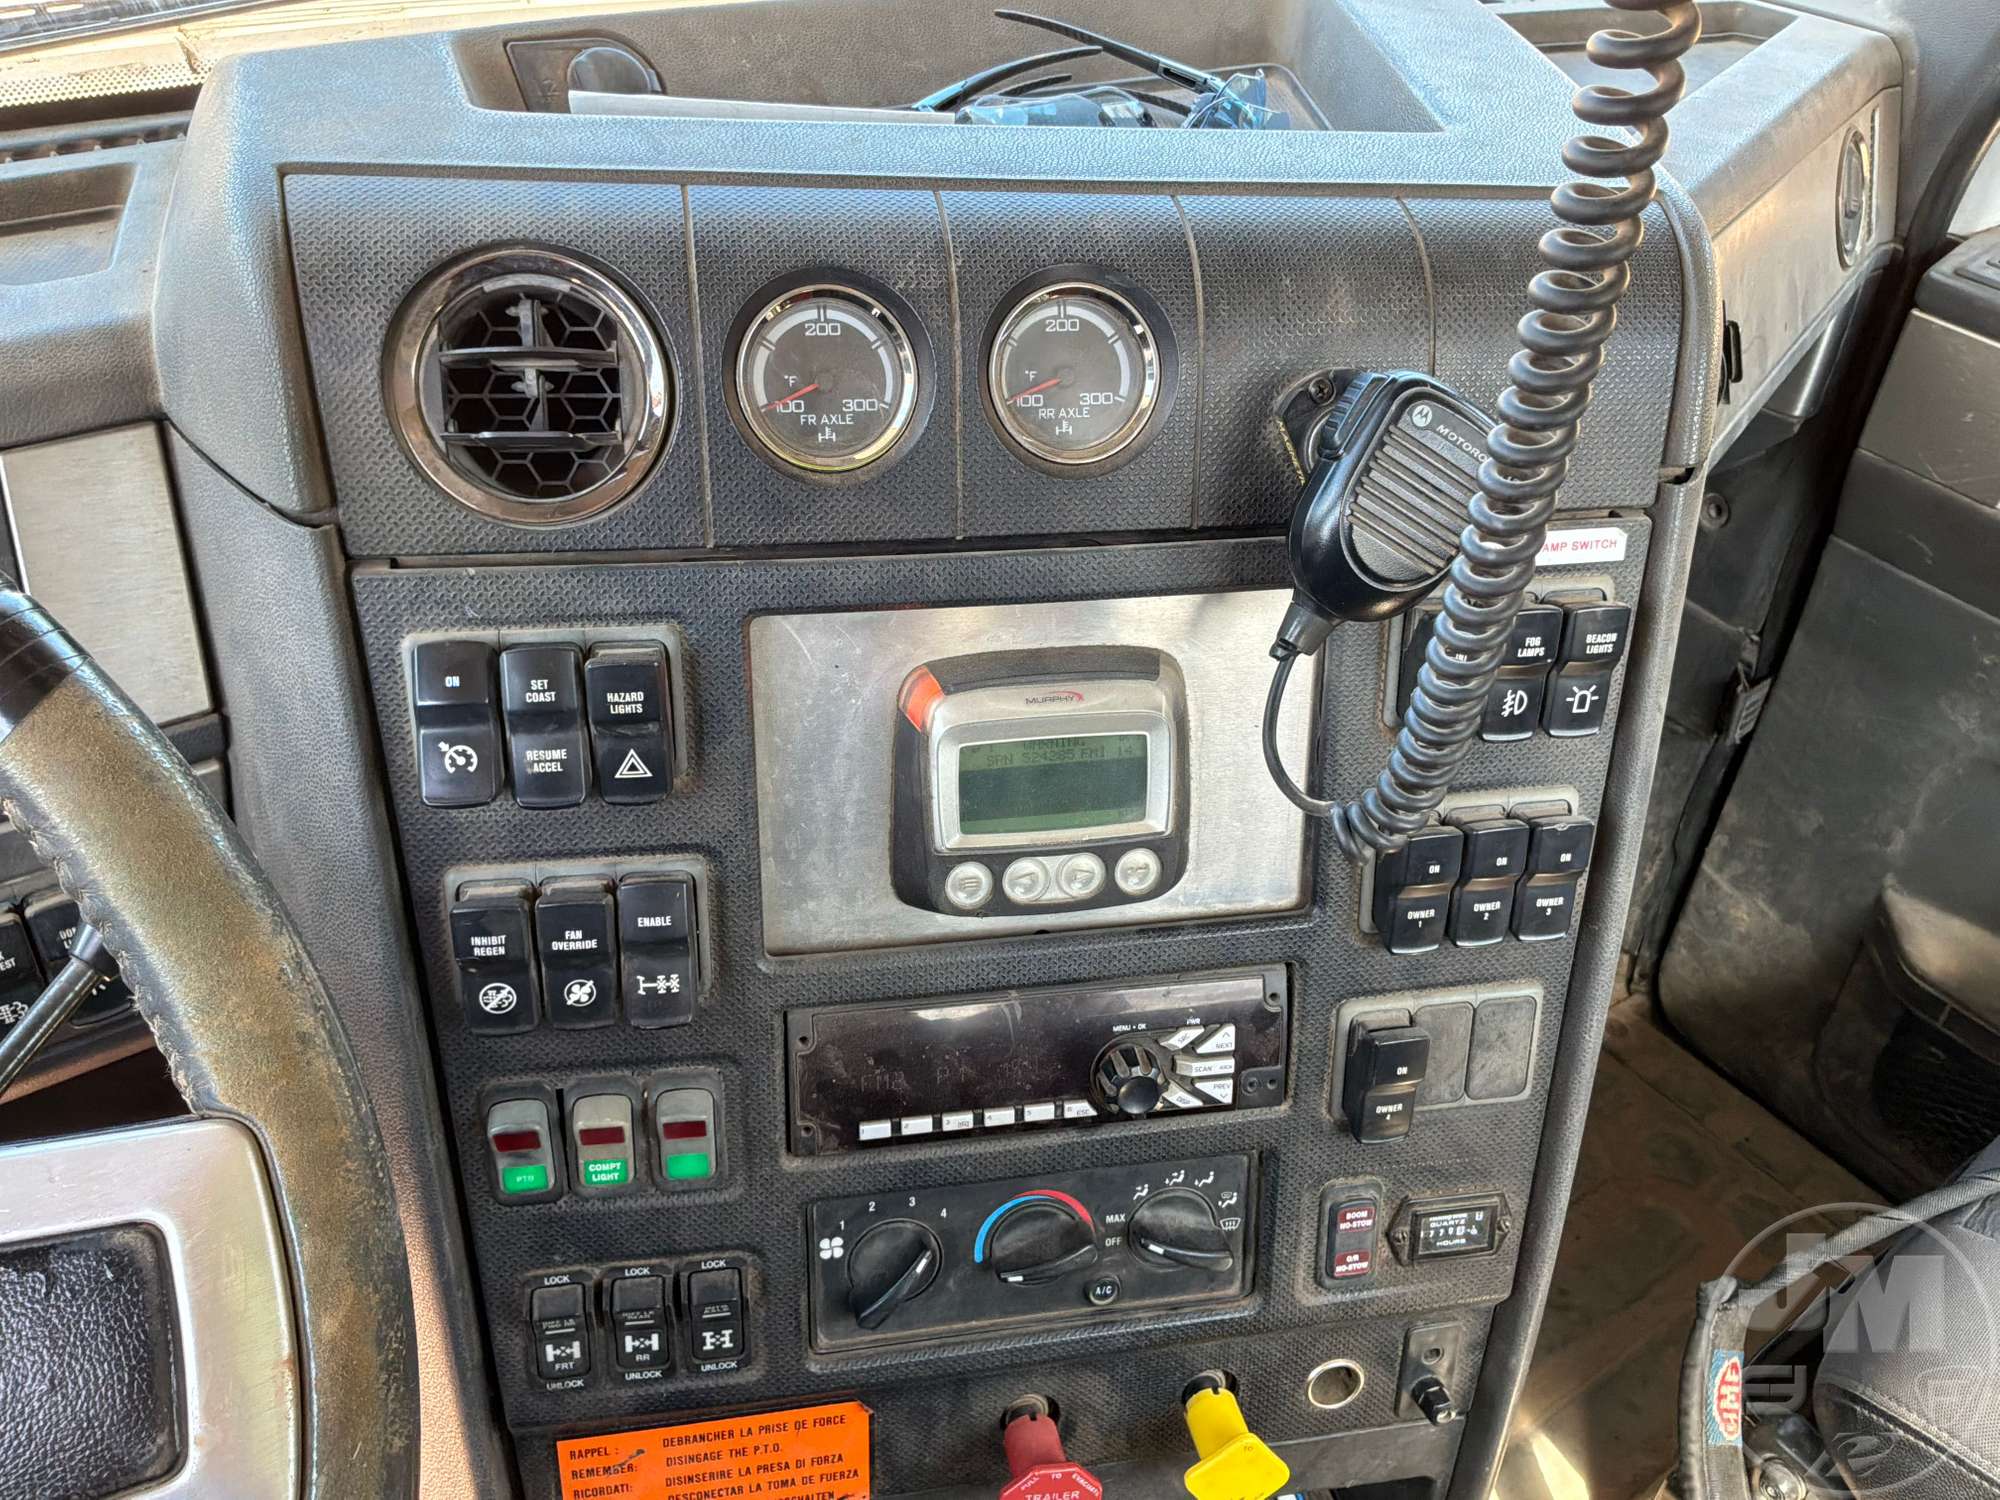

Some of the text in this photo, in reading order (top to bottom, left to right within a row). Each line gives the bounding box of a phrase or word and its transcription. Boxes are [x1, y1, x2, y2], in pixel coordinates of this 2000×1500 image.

[804, 323, 841, 337] 200
[1045, 319, 1080, 332] 200
[1079, 392, 1113, 406] 300
[842, 398, 878, 412] 300
[1038, 407, 1090, 419] RR AXLE
[800, 413, 854, 425] FR AXLE
[1436, 424, 1493, 463] MOTORO
[1542, 539, 1617, 552] AMP SWITCH
[1525, 637, 1541, 647] FOG
[1586, 633, 1618, 644] BEACON
[1517, 647, 1545, 657] LAMPS
[1586, 644, 1613, 654] LIGHTS
[445, 676, 460, 687] ON
[530, 679, 549, 690] SET
[525, 691, 556, 703] COAST
[607, 691, 644, 703] HAZARD
[1025, 694, 1075, 704] MURPHY
[610, 704, 643, 714] LIGHTS
[526, 749, 568, 760] RESUME
[532, 762, 563, 773] ACCEL
[1496, 857, 1507, 866] ON
[1560, 853, 1572, 862] ON
[1429, 865, 1440, 874] ON
[1473, 901, 1501, 911] OWNER
[1536, 897, 1564, 907] OWNER
[1407, 909, 1435, 919] OWNER
[1483, 912, 1489, 920] 2
[637, 916, 672, 927] ENABLE
[471, 935, 507, 946] INHIBIT
[565, 930, 583, 940] FAN
[551, 939, 598, 950] OVERRIDE
[473, 946, 505, 957] REGEN
[1397, 1066, 1408, 1075] ON
[1376, 1103, 1403, 1114] OWNER
[588, 1162, 621, 1172] COMPT
[591, 1172, 620, 1182] LIGHT
[869, 1201, 876, 1212] 2
[909, 1197, 916, 1207] 3
[940, 1208, 947, 1218] 4
[1105, 1213, 1126, 1224] MAX
[839, 1221, 845, 1230] 1
[1105, 1237, 1121, 1247] OFF
[701, 1259, 727, 1269] LOCK
[624, 1266, 650, 1277] LOCK
[544, 1275, 571, 1286] LOCK
[1095, 1284, 1112, 1296] A/C
[635, 1353, 650, 1362] RR
[554, 1361, 575, 1371] FRT
[700, 1361, 738, 1372] UNLOCK
[625, 1370, 662, 1381] UNLOCK
[546, 1379, 585, 1391] UNLOCK
[662, 1414, 847, 1448] DEBRANCHER LA PRISE DE FORCE
[569, 1447, 609, 1460] RAPPEL
[728, 1446, 749, 1457] THE
[665, 1453, 844, 1488] DISINSERIRE LA PRESA DI FORZA
[667, 1469, 859, 1500] DESCONECTAR LA TOMA DE FUERZA
